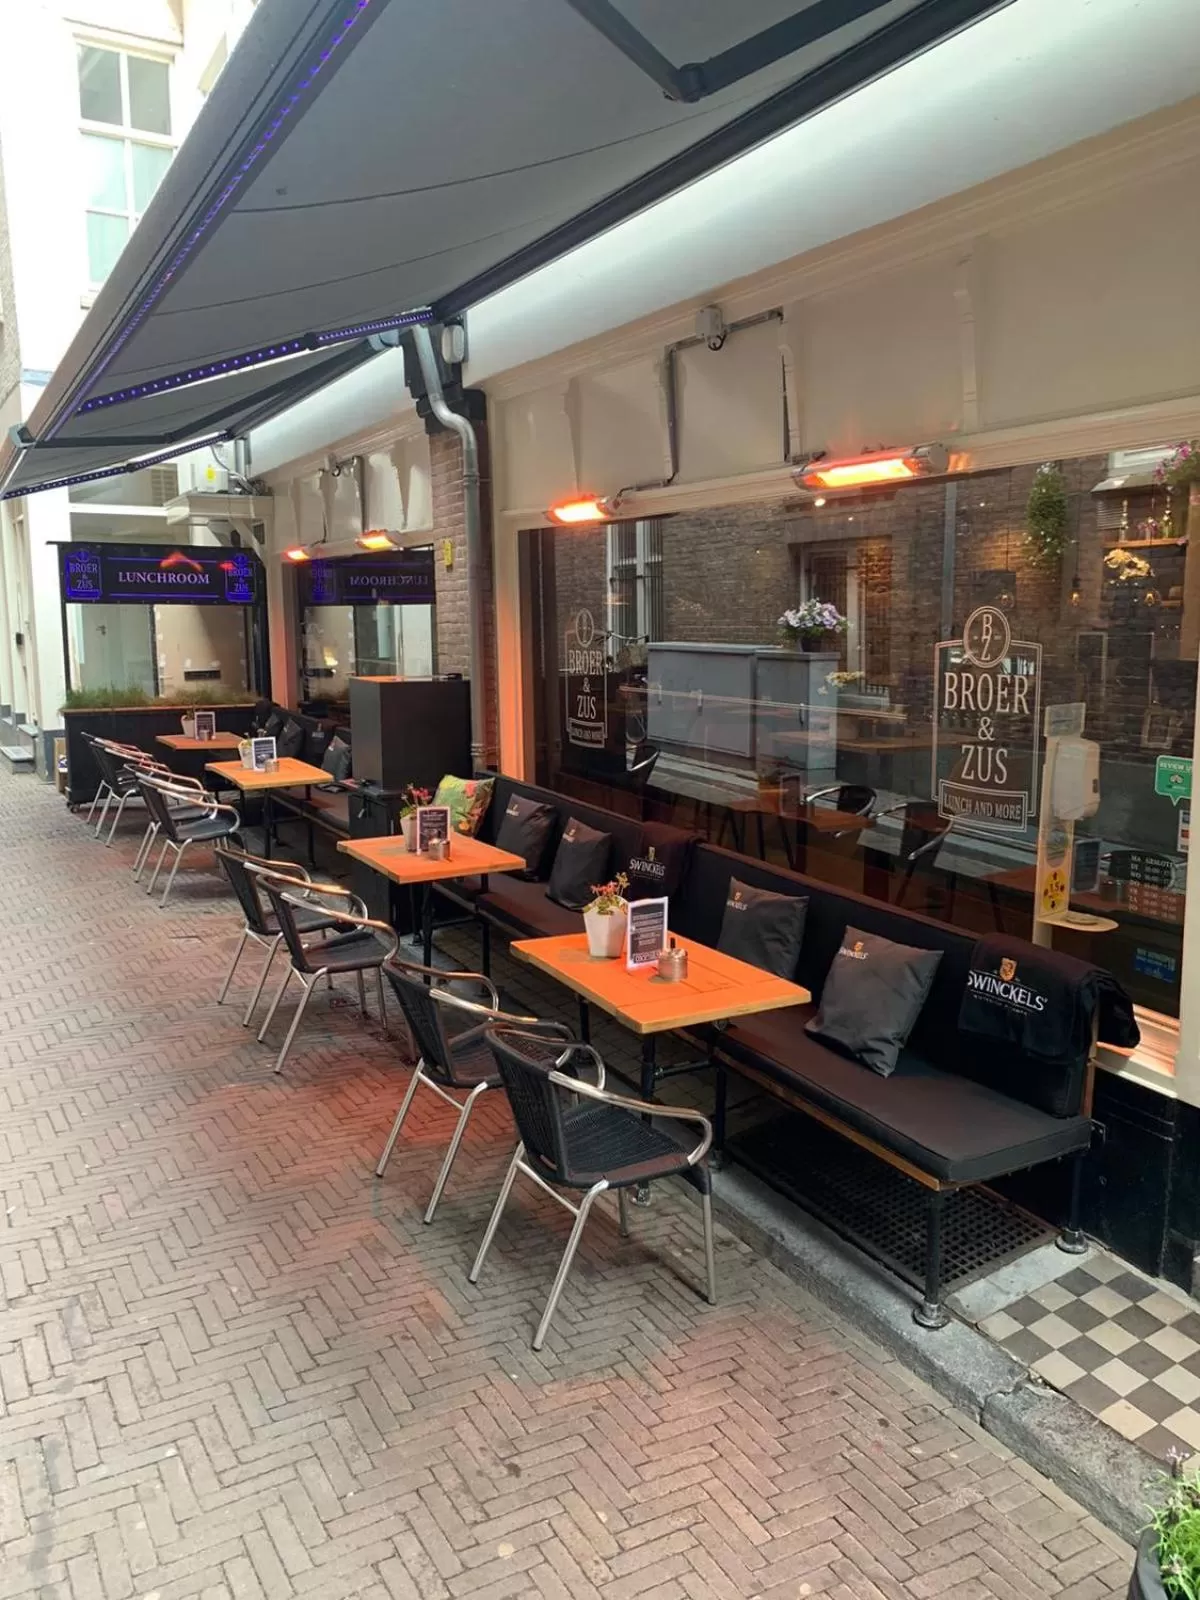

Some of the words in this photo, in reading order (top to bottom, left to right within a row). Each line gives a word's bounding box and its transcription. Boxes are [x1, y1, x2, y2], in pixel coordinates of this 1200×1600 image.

[69, 562, 98, 574] BROER
[118, 571, 210, 585] LUNCHROOM
[568, 649, 604, 676] BROER
[582, 676, 591, 693] &
[943, 671, 1030, 715] BROER
[576, 694, 597, 720] ZUS
[978, 716, 996, 741] &
[961, 744, 1008, 784] ZUS
[943, 792, 972, 814] LUNCH
[973, 799, 993, 817] AND
[994, 801, 1022, 821] MORE
